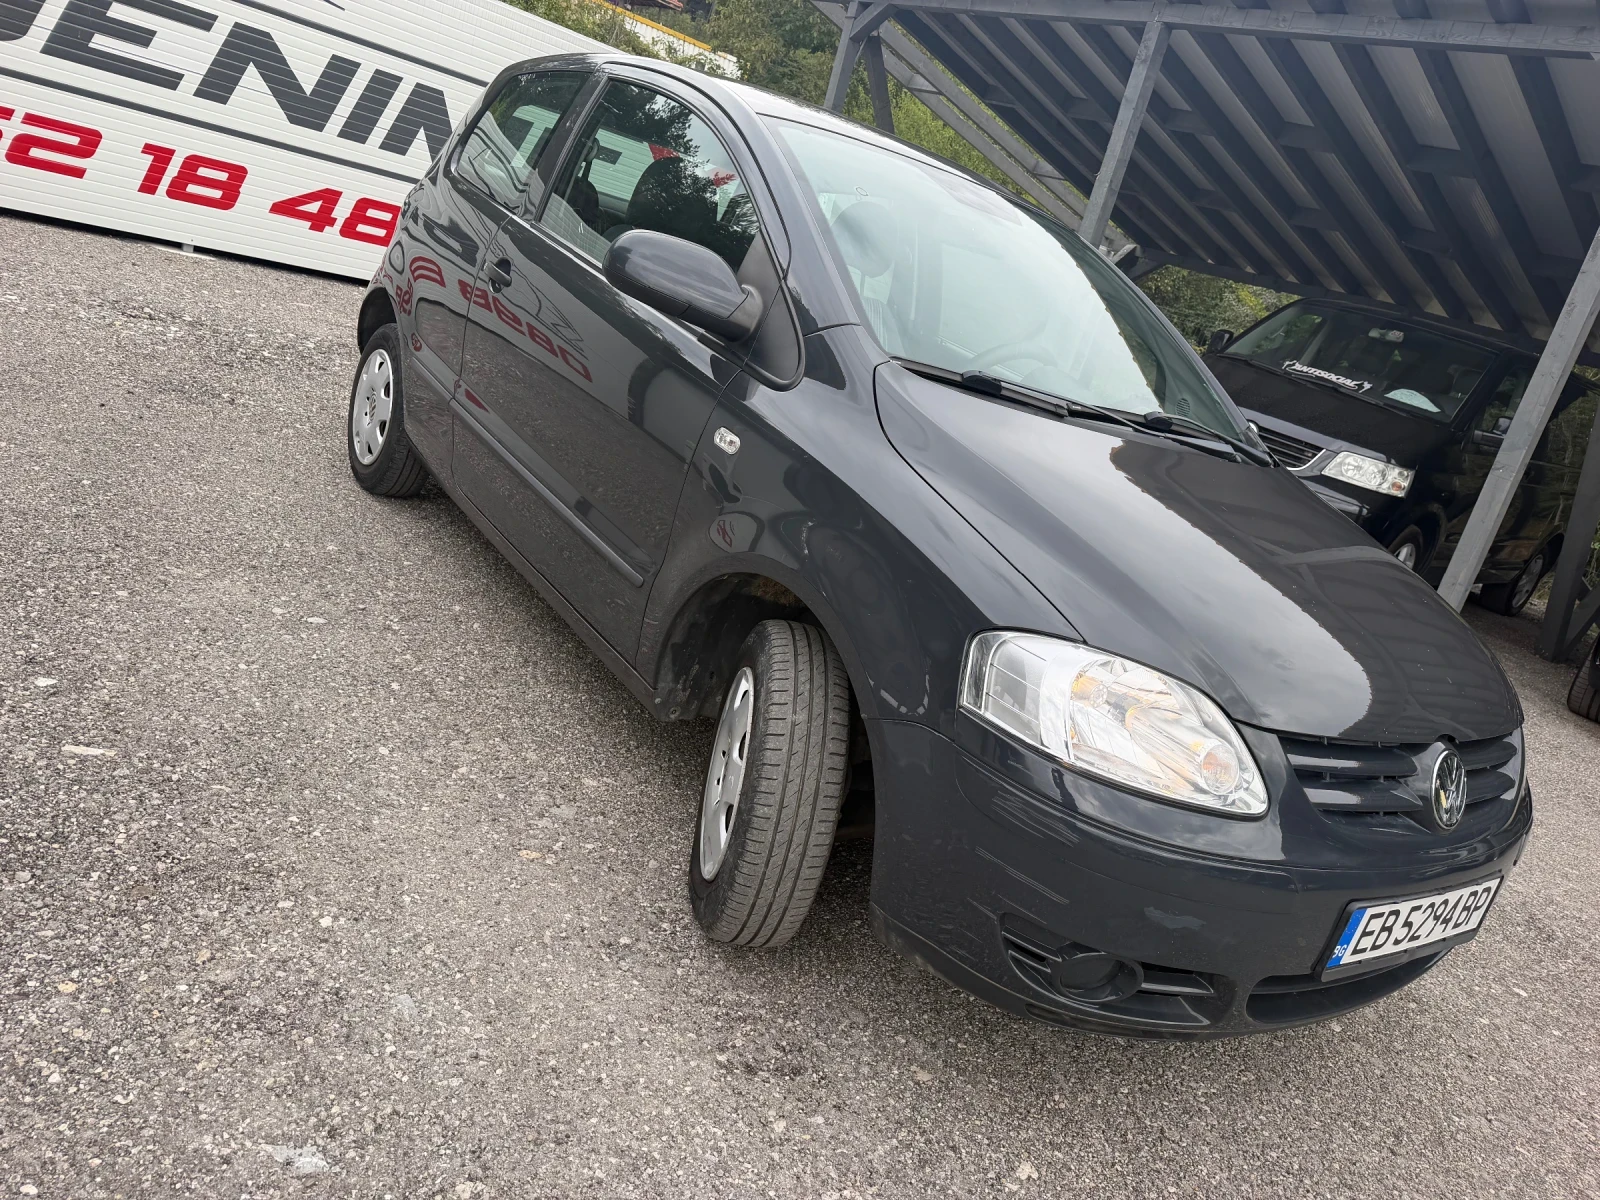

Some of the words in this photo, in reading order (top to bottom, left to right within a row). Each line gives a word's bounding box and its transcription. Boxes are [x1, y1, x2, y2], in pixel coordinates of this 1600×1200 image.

[0, 106, 103, 179] 2
[137, 143, 248, 211] 18
[269, 188, 401, 247] 48
